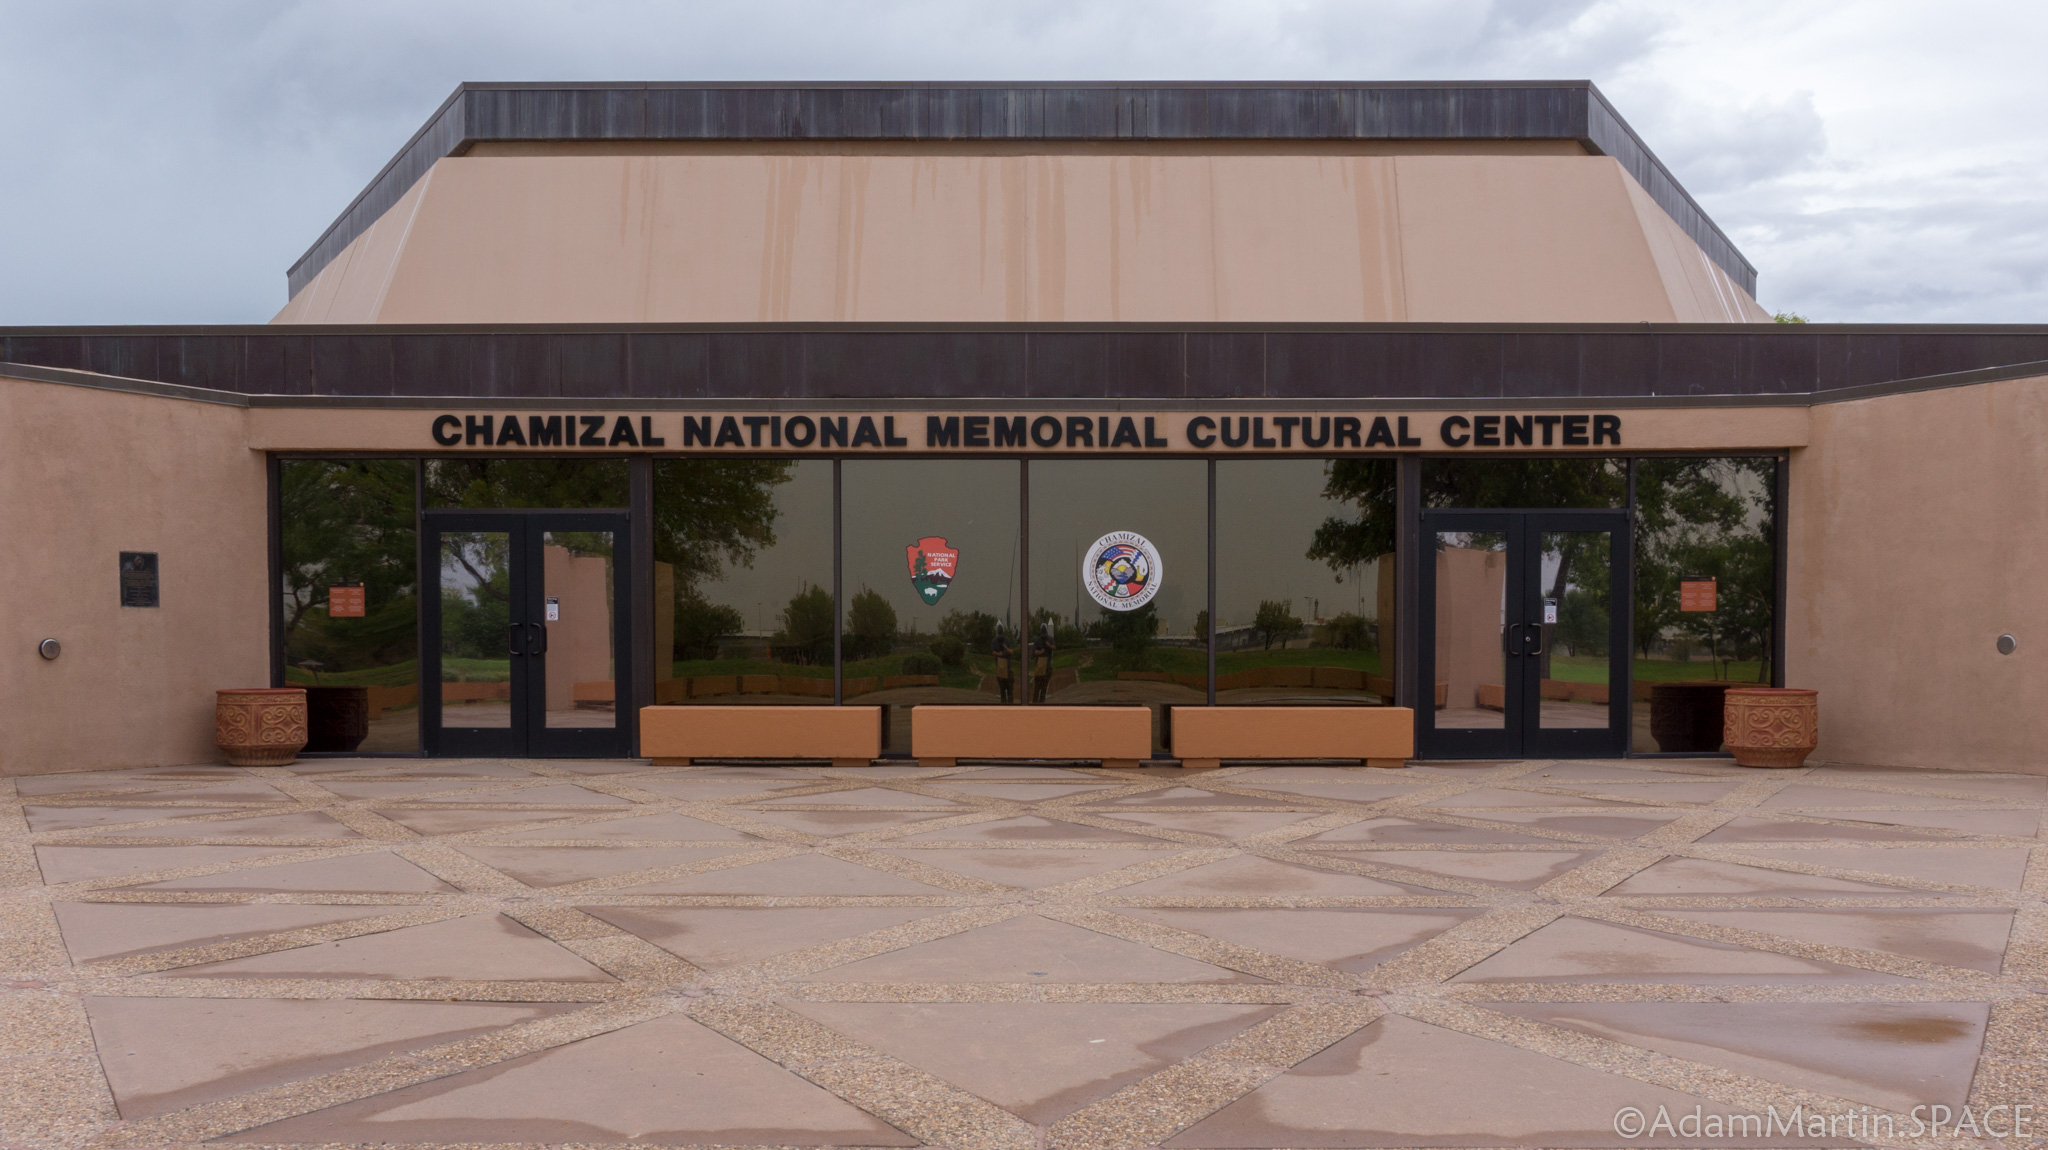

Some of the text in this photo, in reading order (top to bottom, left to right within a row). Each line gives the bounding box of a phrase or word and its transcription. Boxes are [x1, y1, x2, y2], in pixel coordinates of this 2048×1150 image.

[432, 414, 1622, 448] CHAMIZAL NATIONAL MEMORIAL CULTURAL CENTER
[1099, 533, 1146, 548] CHAMIZAL
[1087, 580, 1158, 609] NATIONAL MEMORIAL
